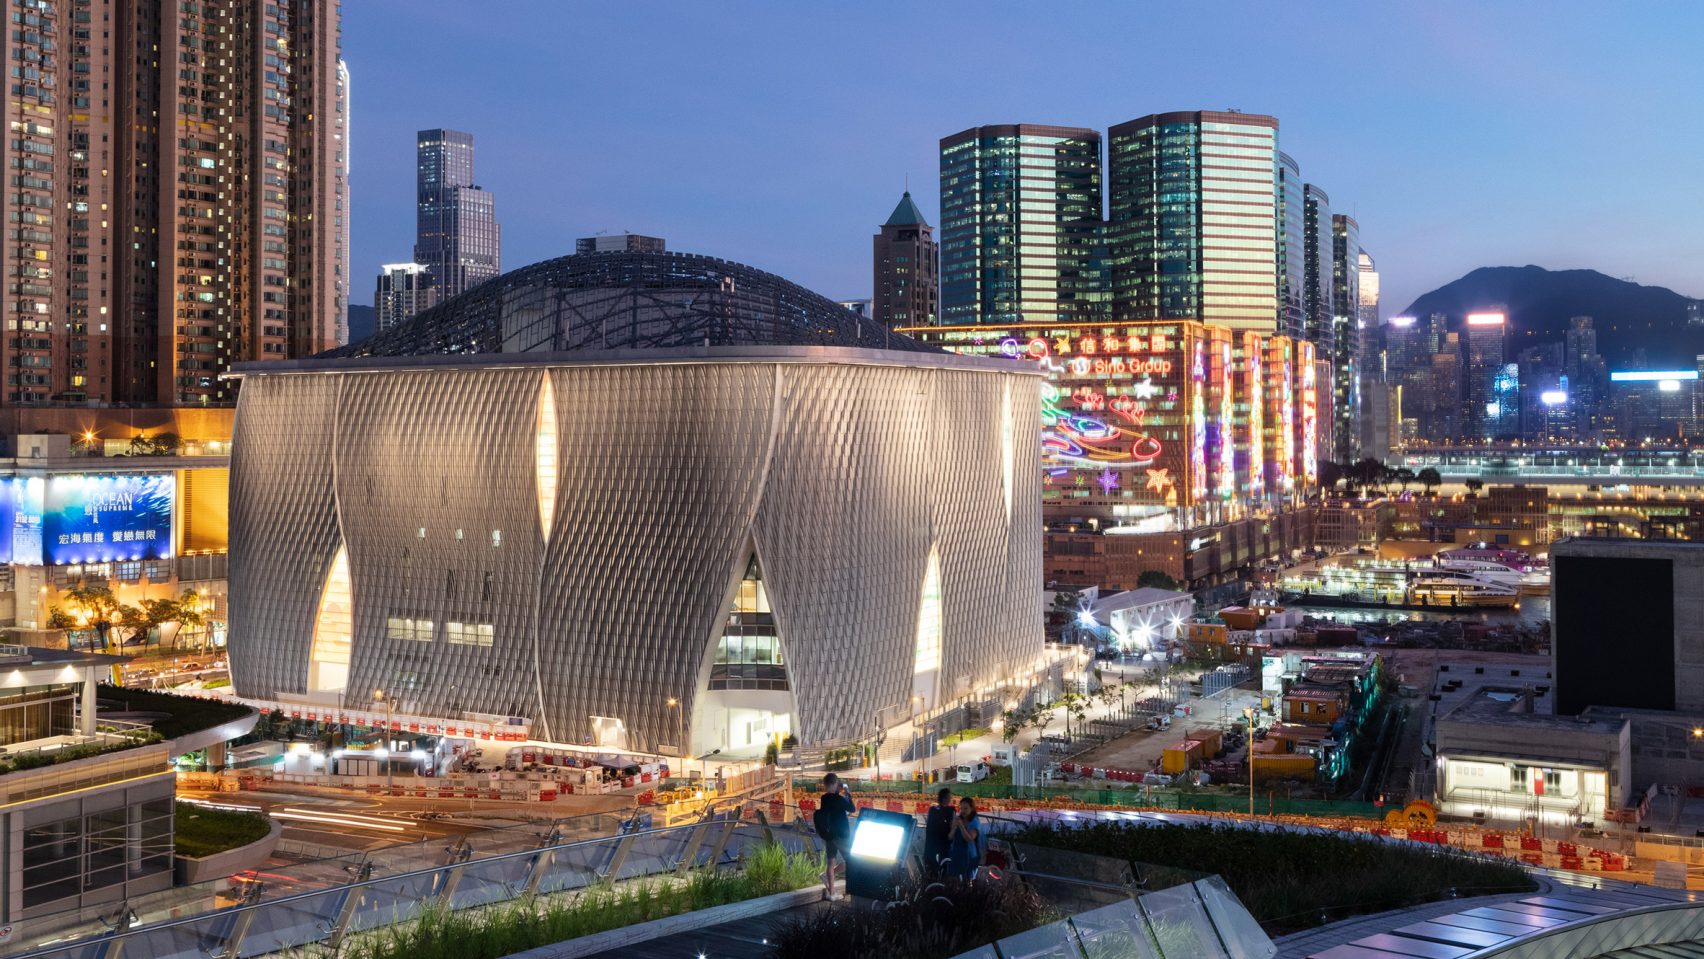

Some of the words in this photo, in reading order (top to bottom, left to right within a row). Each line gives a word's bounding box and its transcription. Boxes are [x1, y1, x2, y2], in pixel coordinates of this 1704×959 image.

[1080, 335, 1166, 354] 信和集團
[1095, 360, 1125, 374] Sino
[1129, 359, 1171, 375] Group
[92, 492, 133, 506] OCEAN
